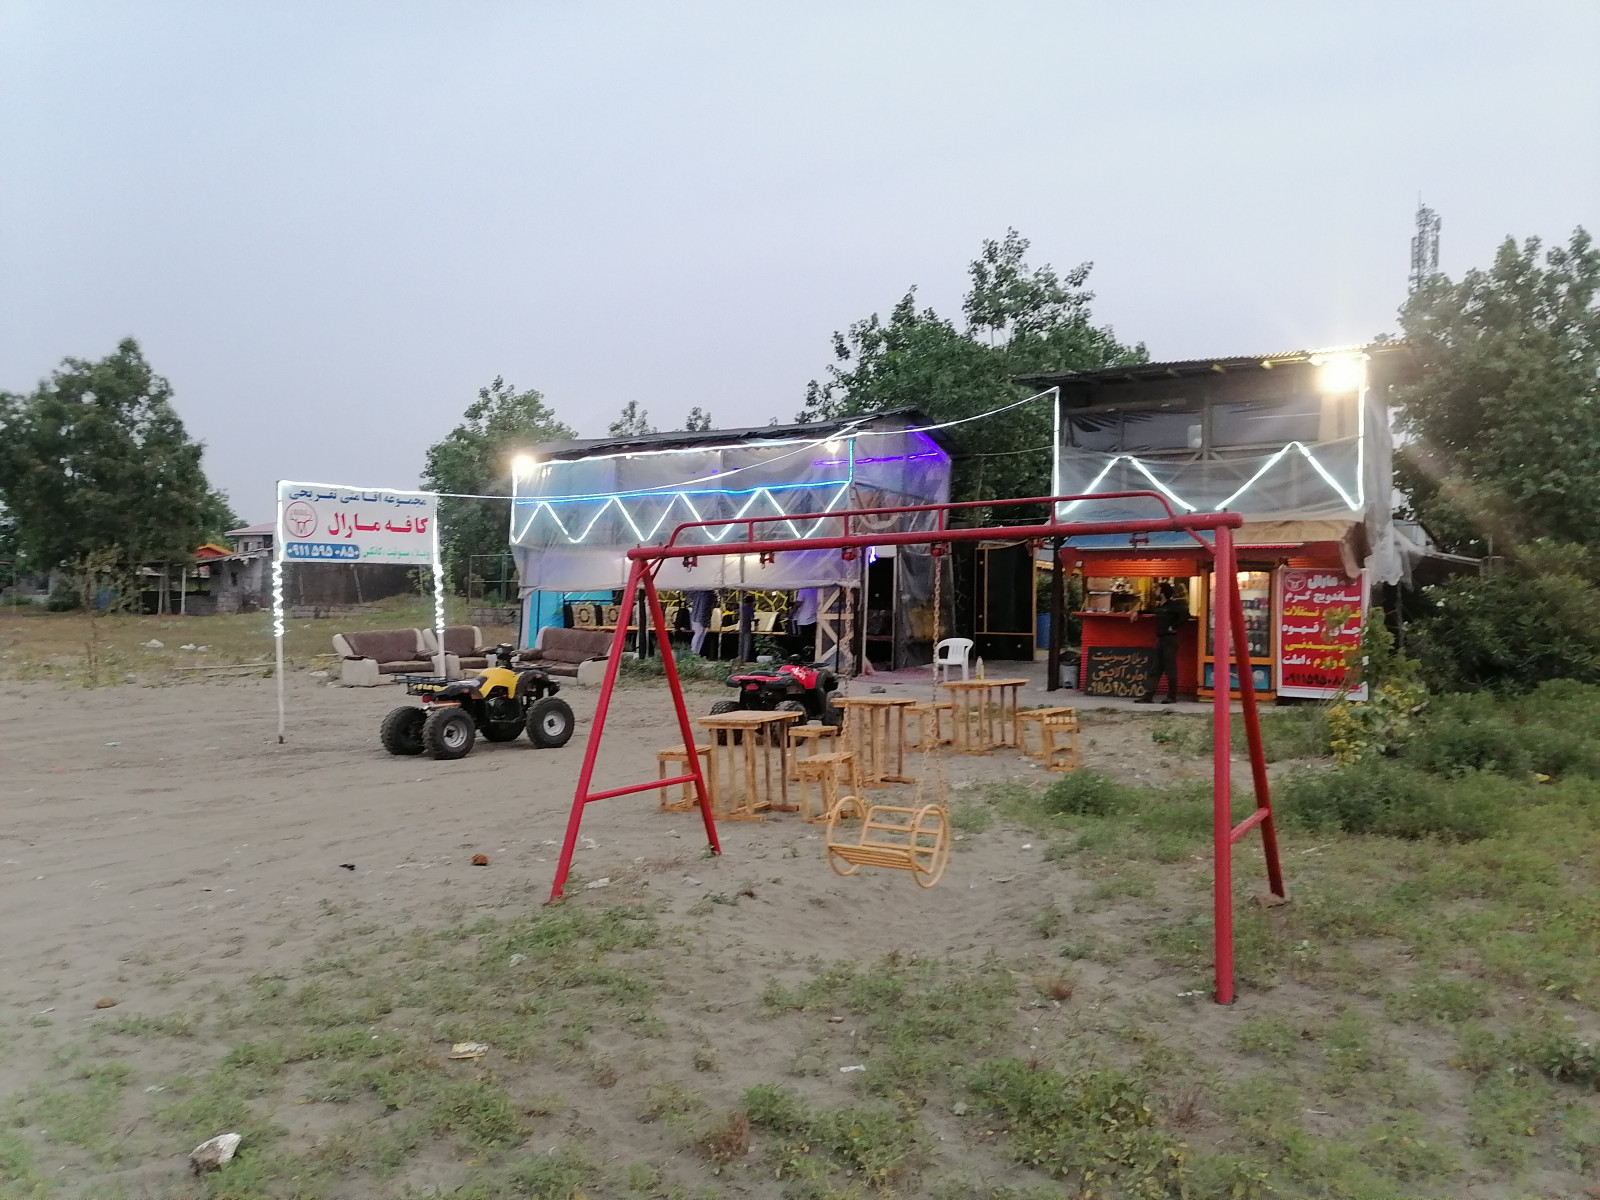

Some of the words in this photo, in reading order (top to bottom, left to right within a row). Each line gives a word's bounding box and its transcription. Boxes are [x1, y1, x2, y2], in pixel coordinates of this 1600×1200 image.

[289, 489, 337, 502] تفریحی
[384, 496, 426, 508] مجموعه
[328, 512, 380, 538] مارال
[385, 515, 428, 534] کافه
[1282, 621, 1319, 635] قهوه
